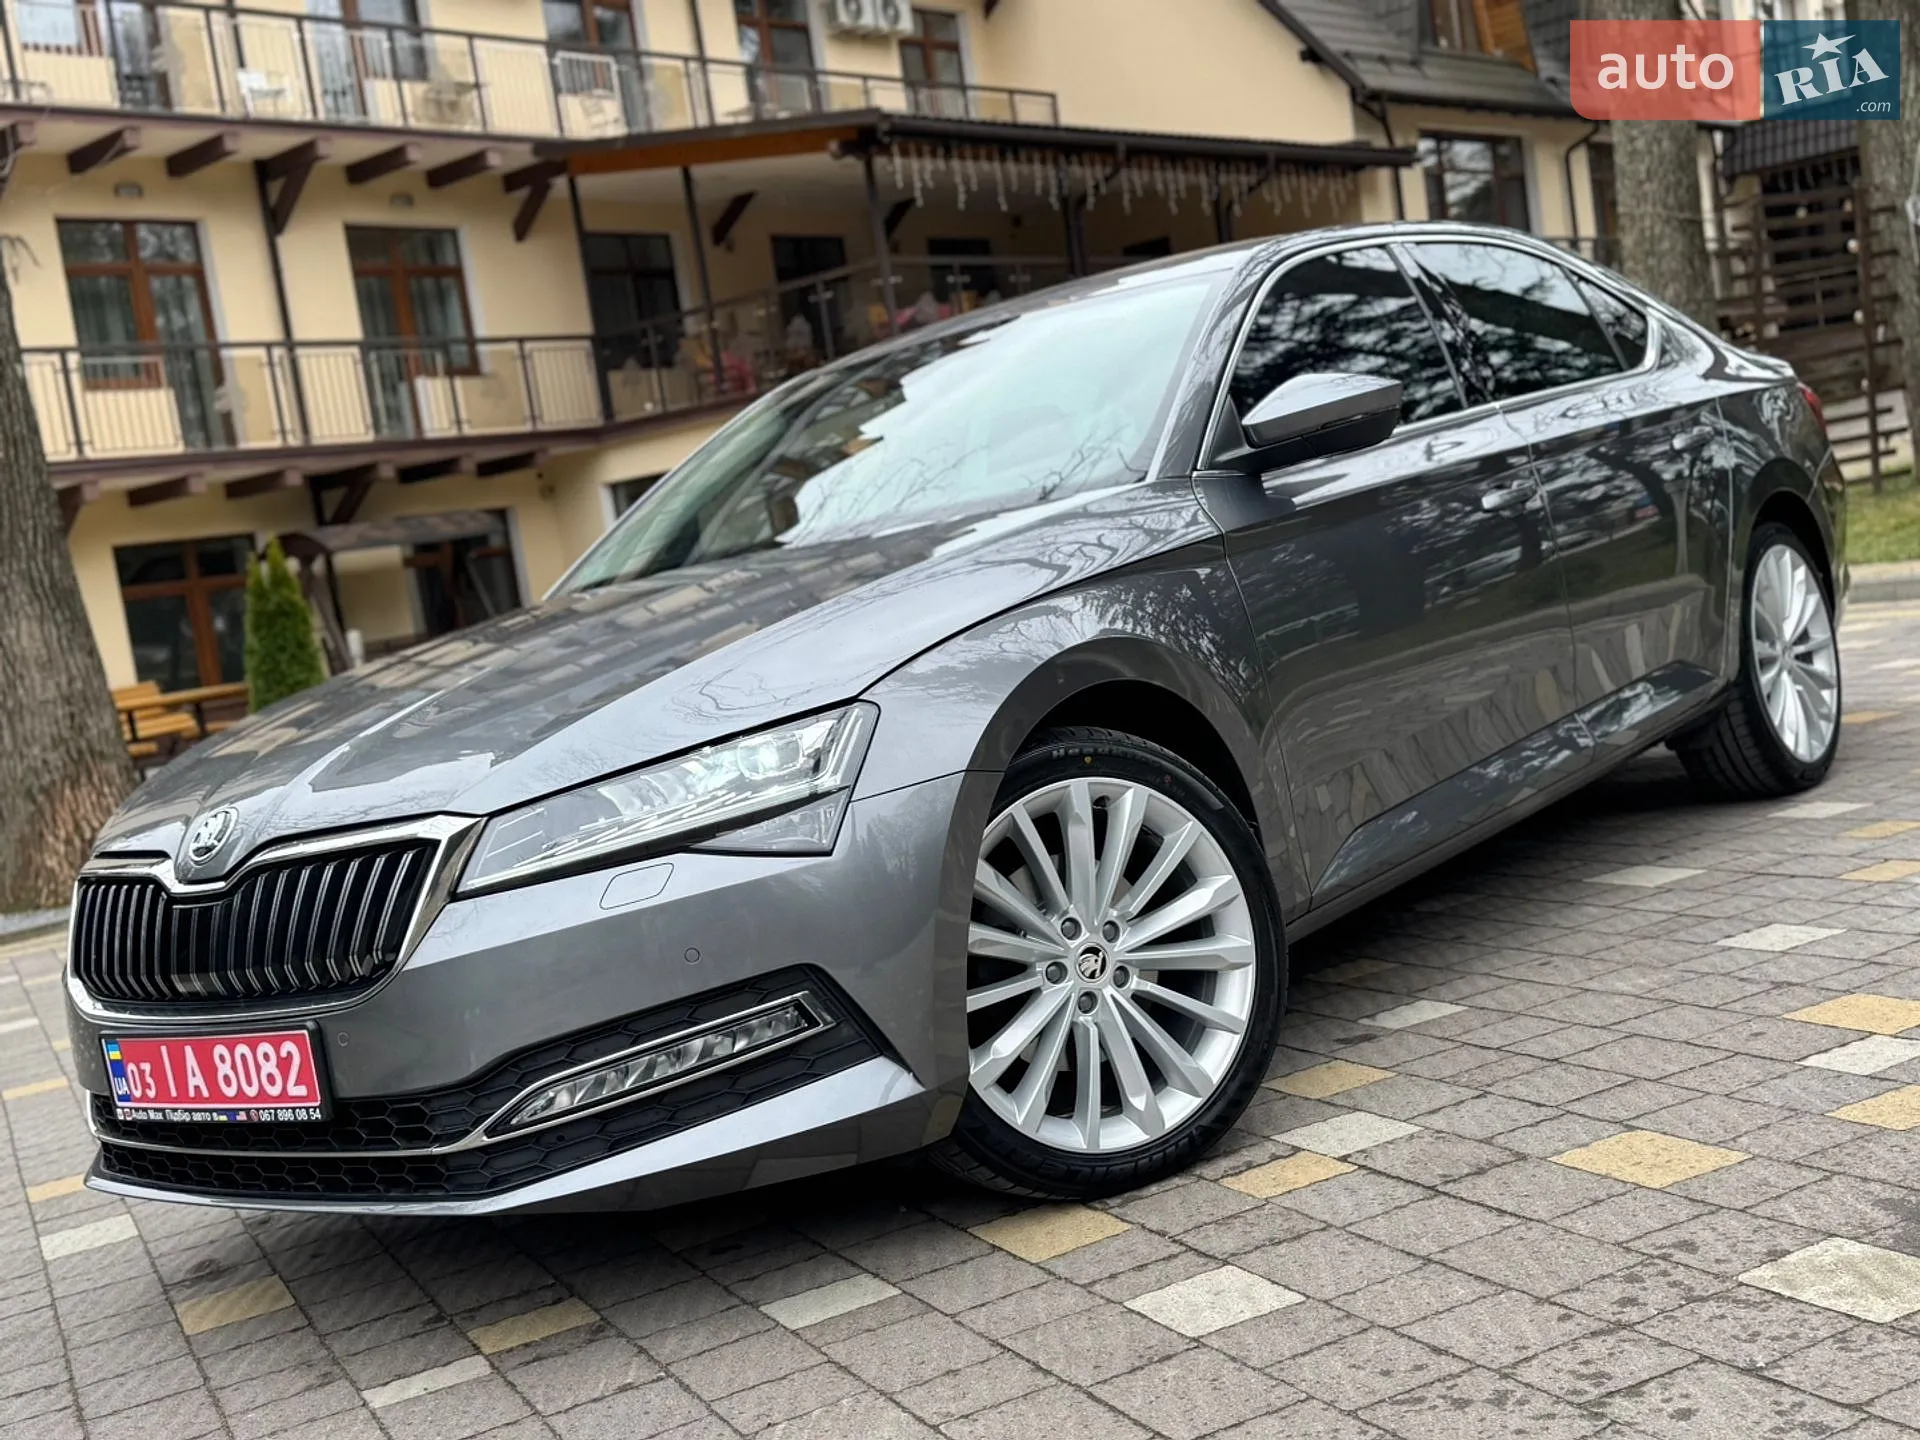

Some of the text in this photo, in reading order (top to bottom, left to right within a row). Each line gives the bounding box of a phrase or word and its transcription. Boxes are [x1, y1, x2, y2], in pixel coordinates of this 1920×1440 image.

[127, 1062, 157, 1098] 03
[213, 1040, 308, 1098] 8082
[114, 1077, 129, 1096] UA
[259, 1109, 275, 1121] 067
[309, 1107, 321, 1120] 54
